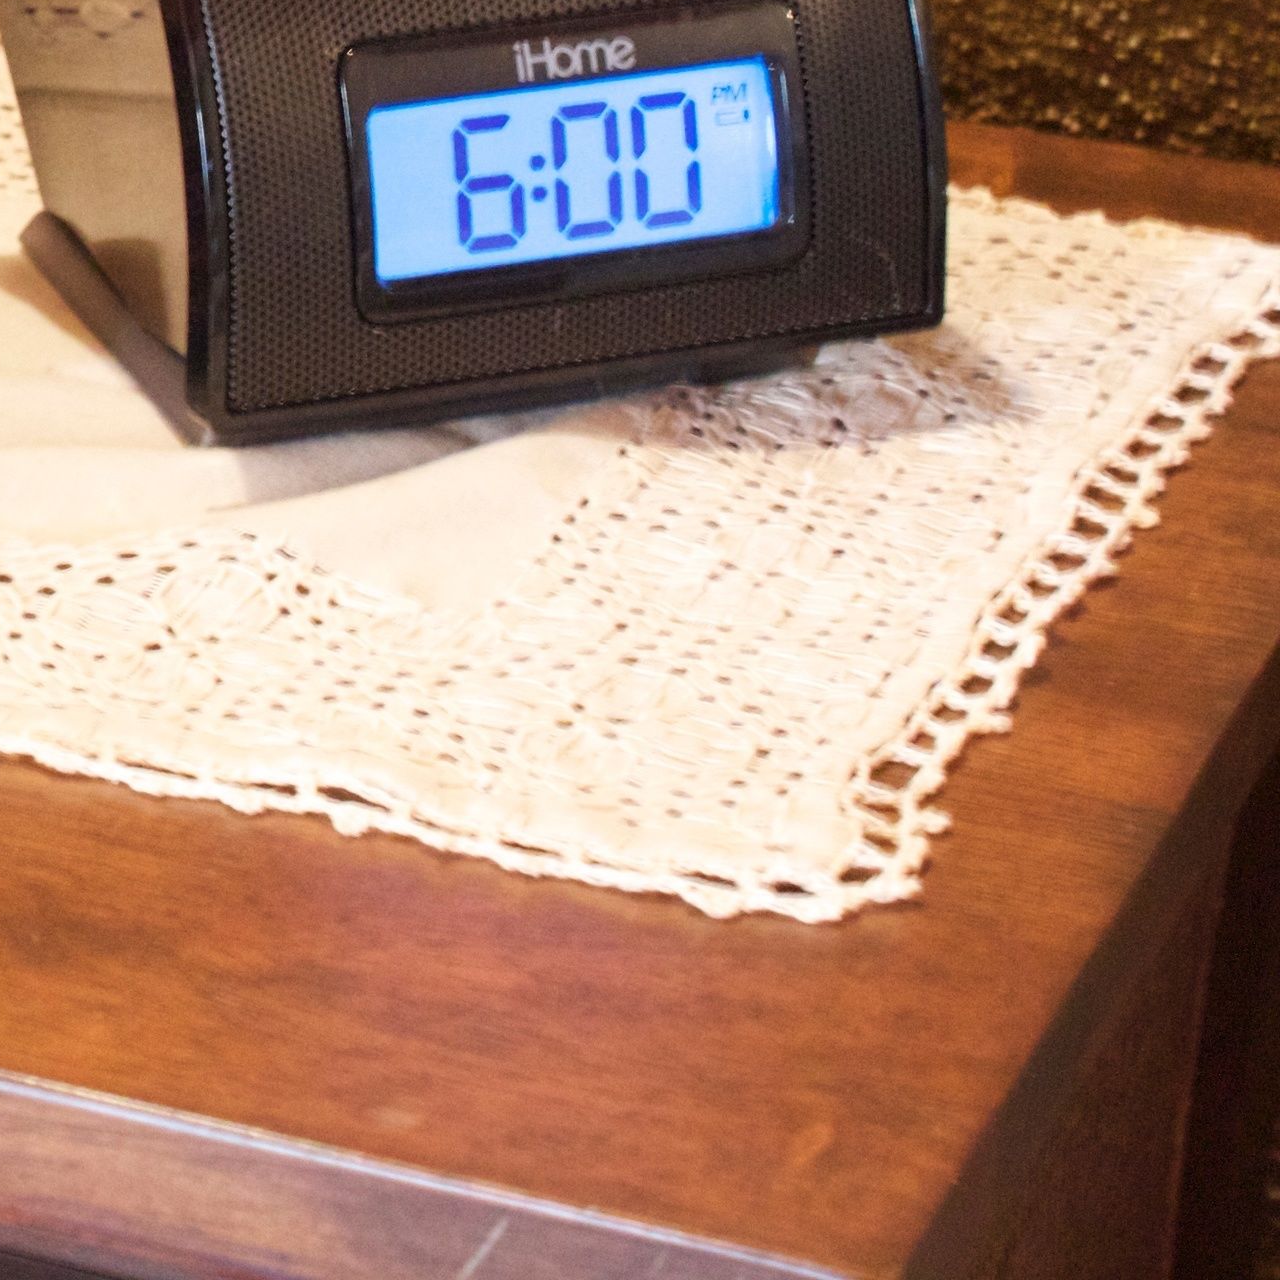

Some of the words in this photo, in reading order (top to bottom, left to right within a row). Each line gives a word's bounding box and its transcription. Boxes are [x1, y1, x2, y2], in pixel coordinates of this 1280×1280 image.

[513, 36, 637, 83] iHome
[451, 90, 701, 254] 6:00
[711, 80, 748, 106] PM
